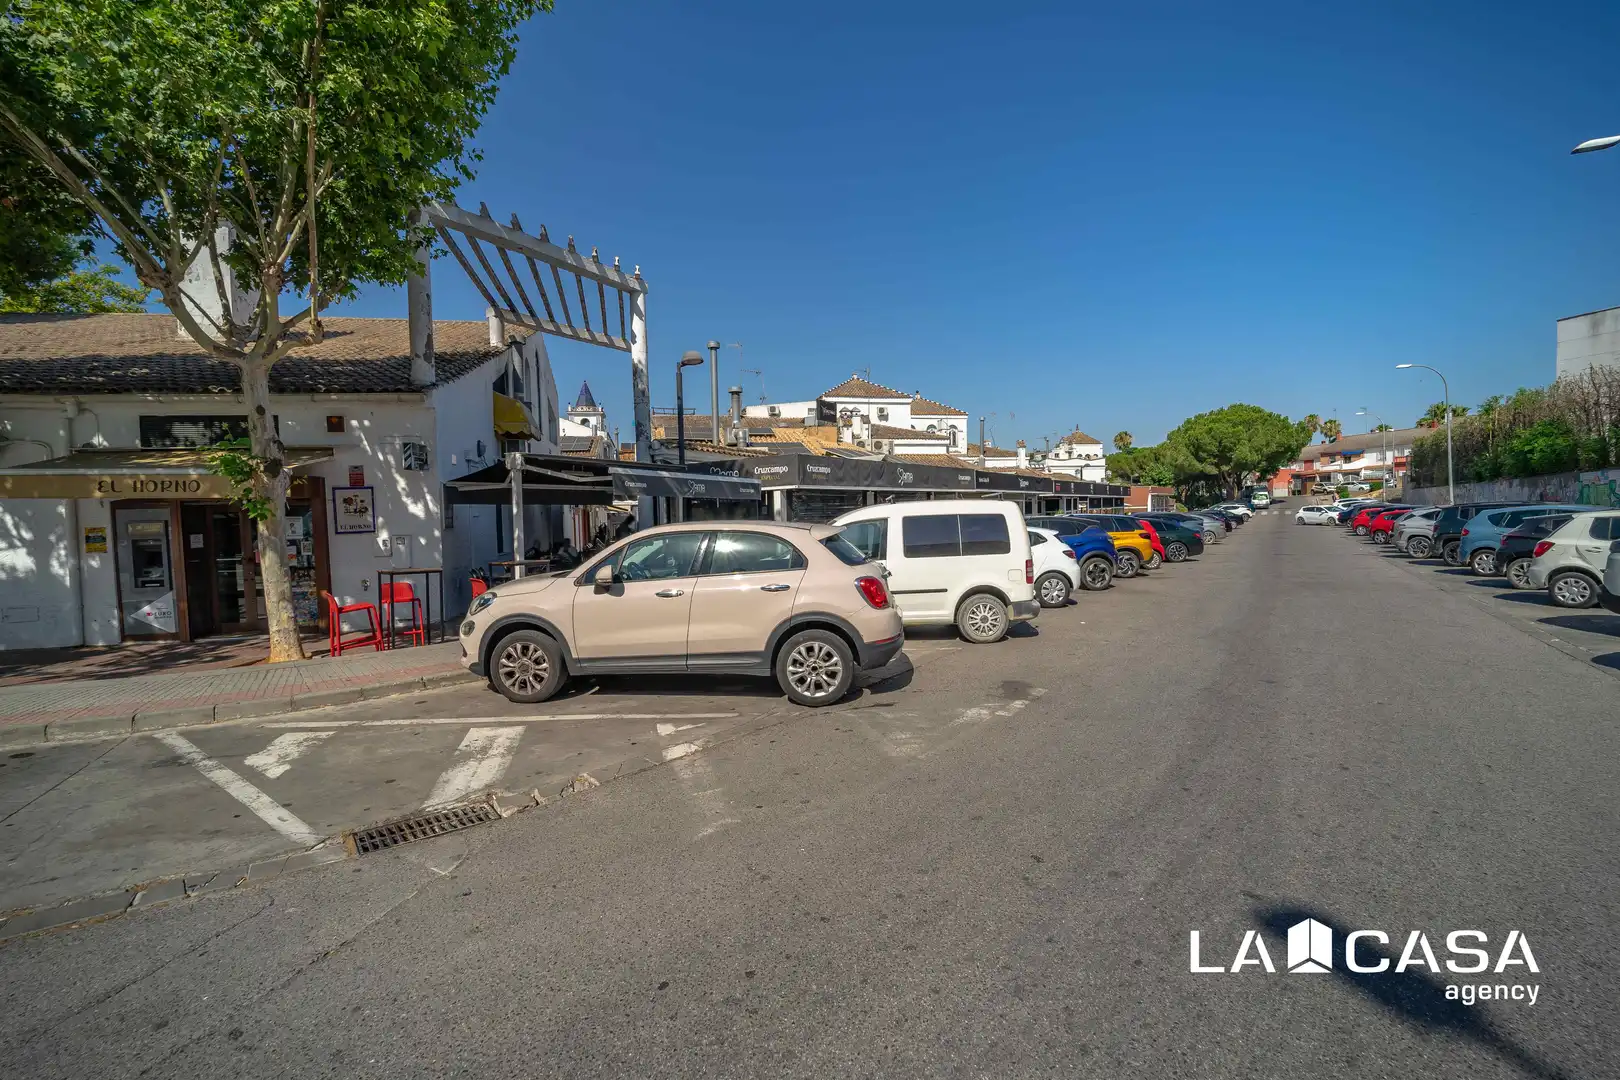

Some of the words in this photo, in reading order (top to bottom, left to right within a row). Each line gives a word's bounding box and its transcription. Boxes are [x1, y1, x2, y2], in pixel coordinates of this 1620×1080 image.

[754, 465, 789, 475] Cruzcampo
[806, 464, 831, 474] Cruzcampo
[97, 480, 122, 493] EL
[132, 480, 201, 493] HORNO
[624, 480, 648, 489] Cruzcampo
